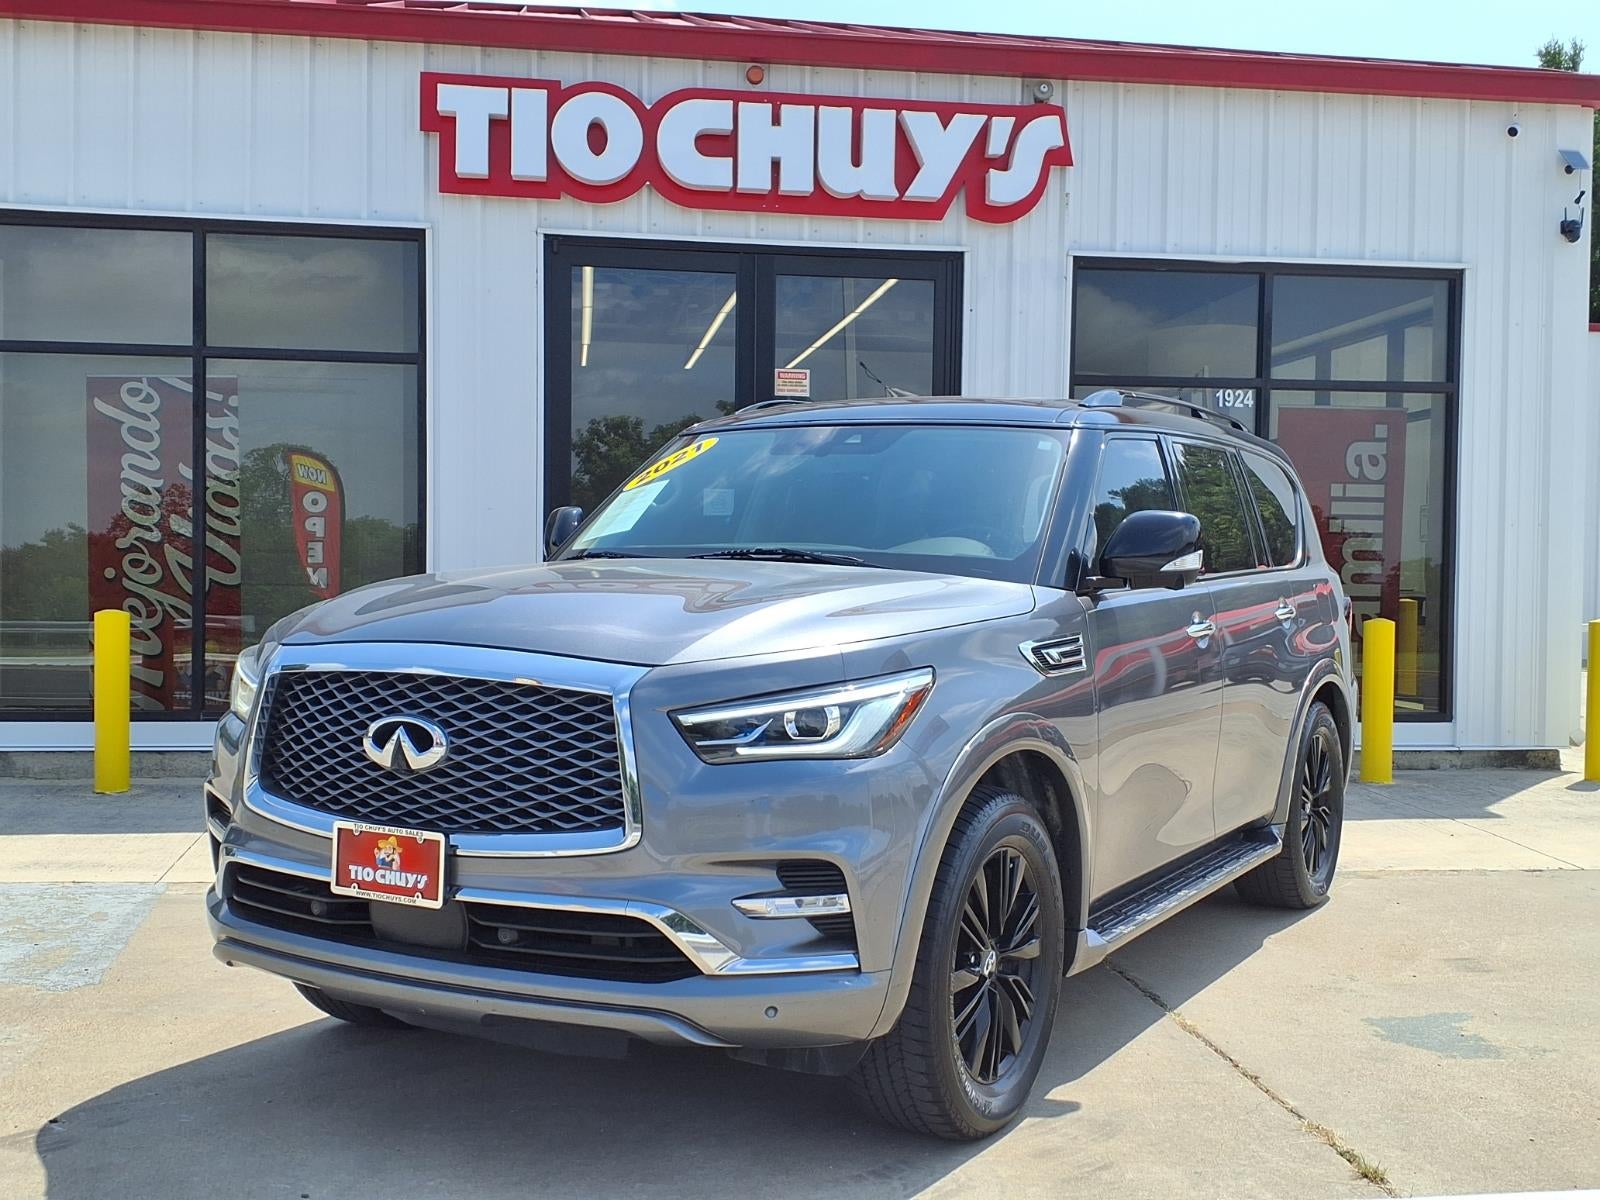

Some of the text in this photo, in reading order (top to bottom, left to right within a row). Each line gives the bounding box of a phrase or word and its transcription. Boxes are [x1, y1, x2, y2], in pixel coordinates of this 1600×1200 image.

[436, 83, 1064, 206] TIO CHUY'S
[1215, 389, 1254, 408] 1924
[634, 443, 703, 486] 2021
[1329, 423, 1388, 660] milia.
[405, 829, 424, 837] SALES
[348, 864, 428, 889] TIO CHUY'S
[356, 890, 416, 904] WWW.TIOCHUYS.COM
